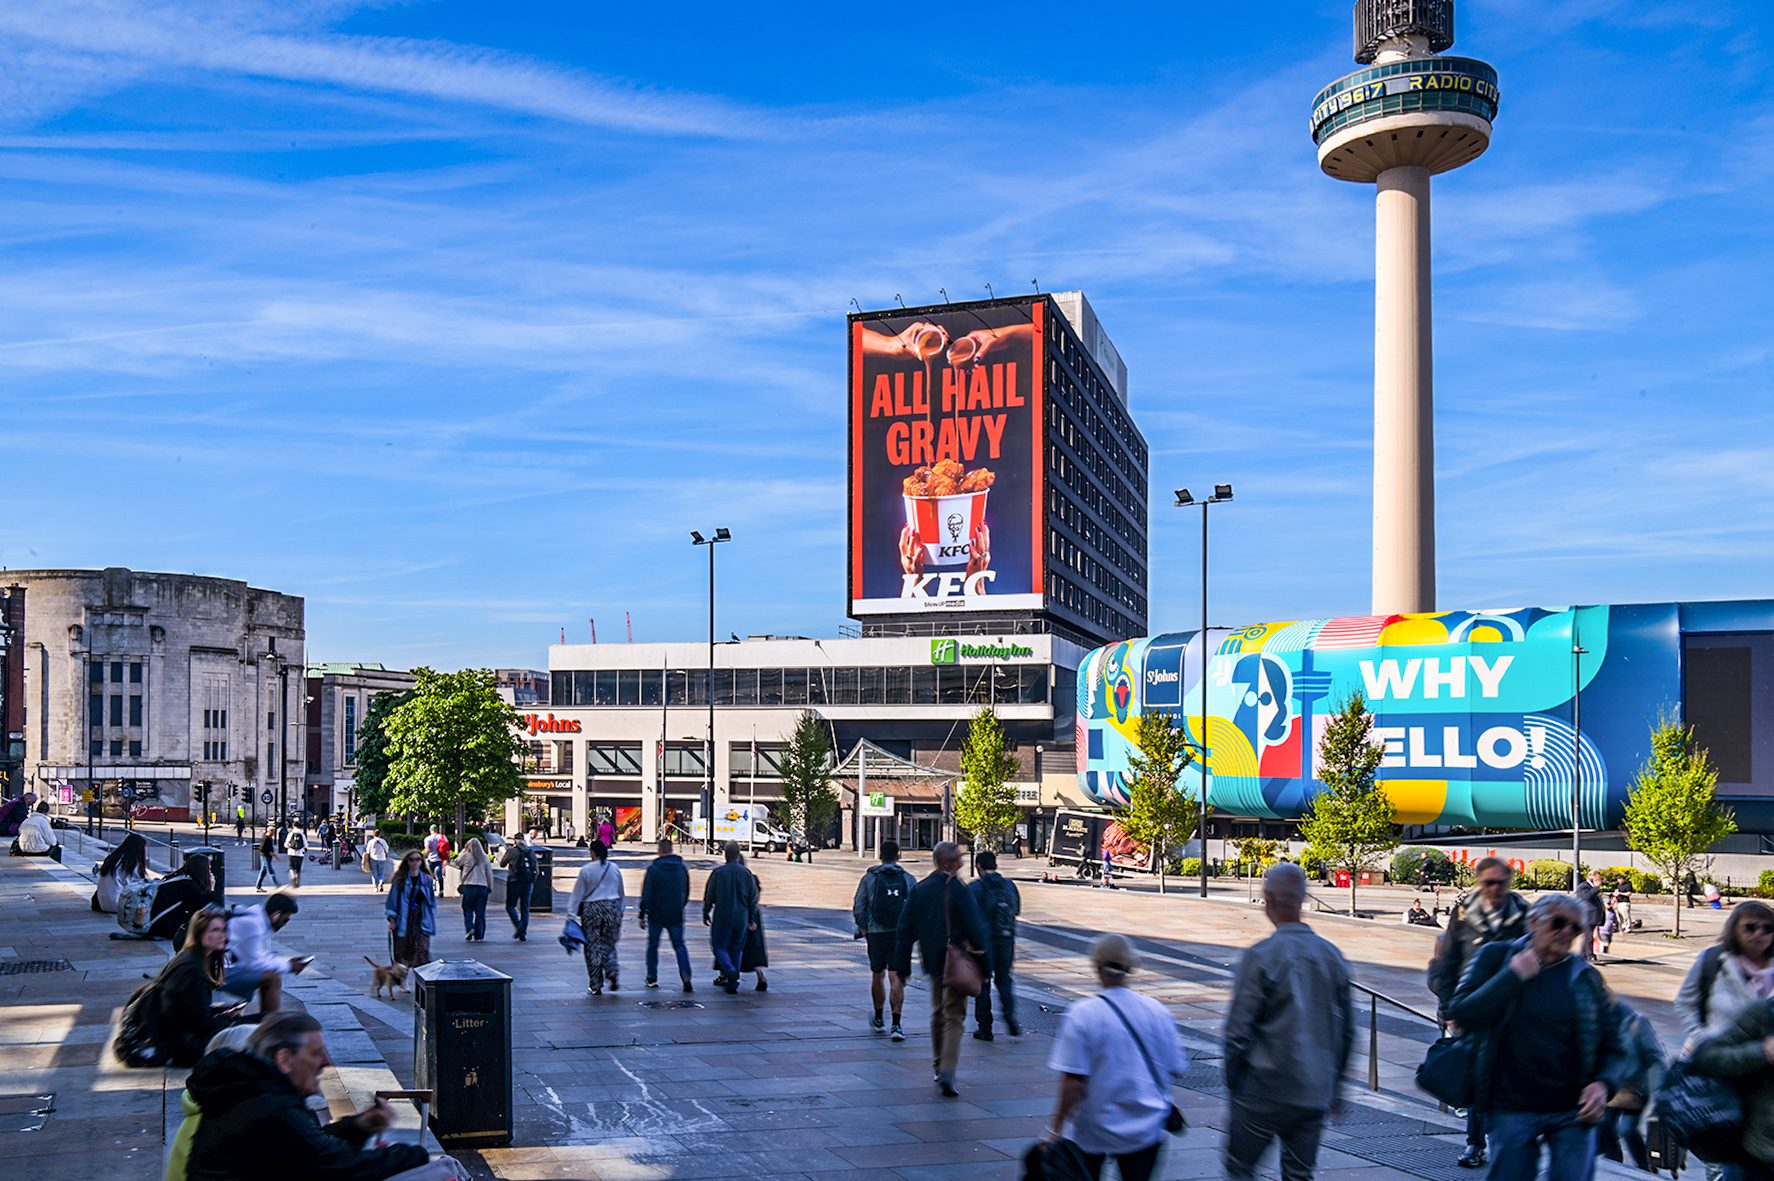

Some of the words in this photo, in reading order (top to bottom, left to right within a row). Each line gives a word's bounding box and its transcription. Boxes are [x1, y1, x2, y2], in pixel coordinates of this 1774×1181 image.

[1409, 75, 1472, 90] RADIO
[1476, 79, 1498, 102] CITY
[870, 371, 928, 418] ALL
[942, 362, 1025, 412] HAIL
[886, 413, 1007, 466] GRAVY
[939, 543, 970, 558] KFC
[901, 570, 996, 598] KFC
[961, 643, 1010, 660] Holiday
[1011, 643, 1033, 657] Inn
[1358, 655, 1515, 700] WHY
[1371, 726, 1546, 769] ELLO!
[555, 780, 571, 788] Local
[455, 1018, 485, 1029] Litter
